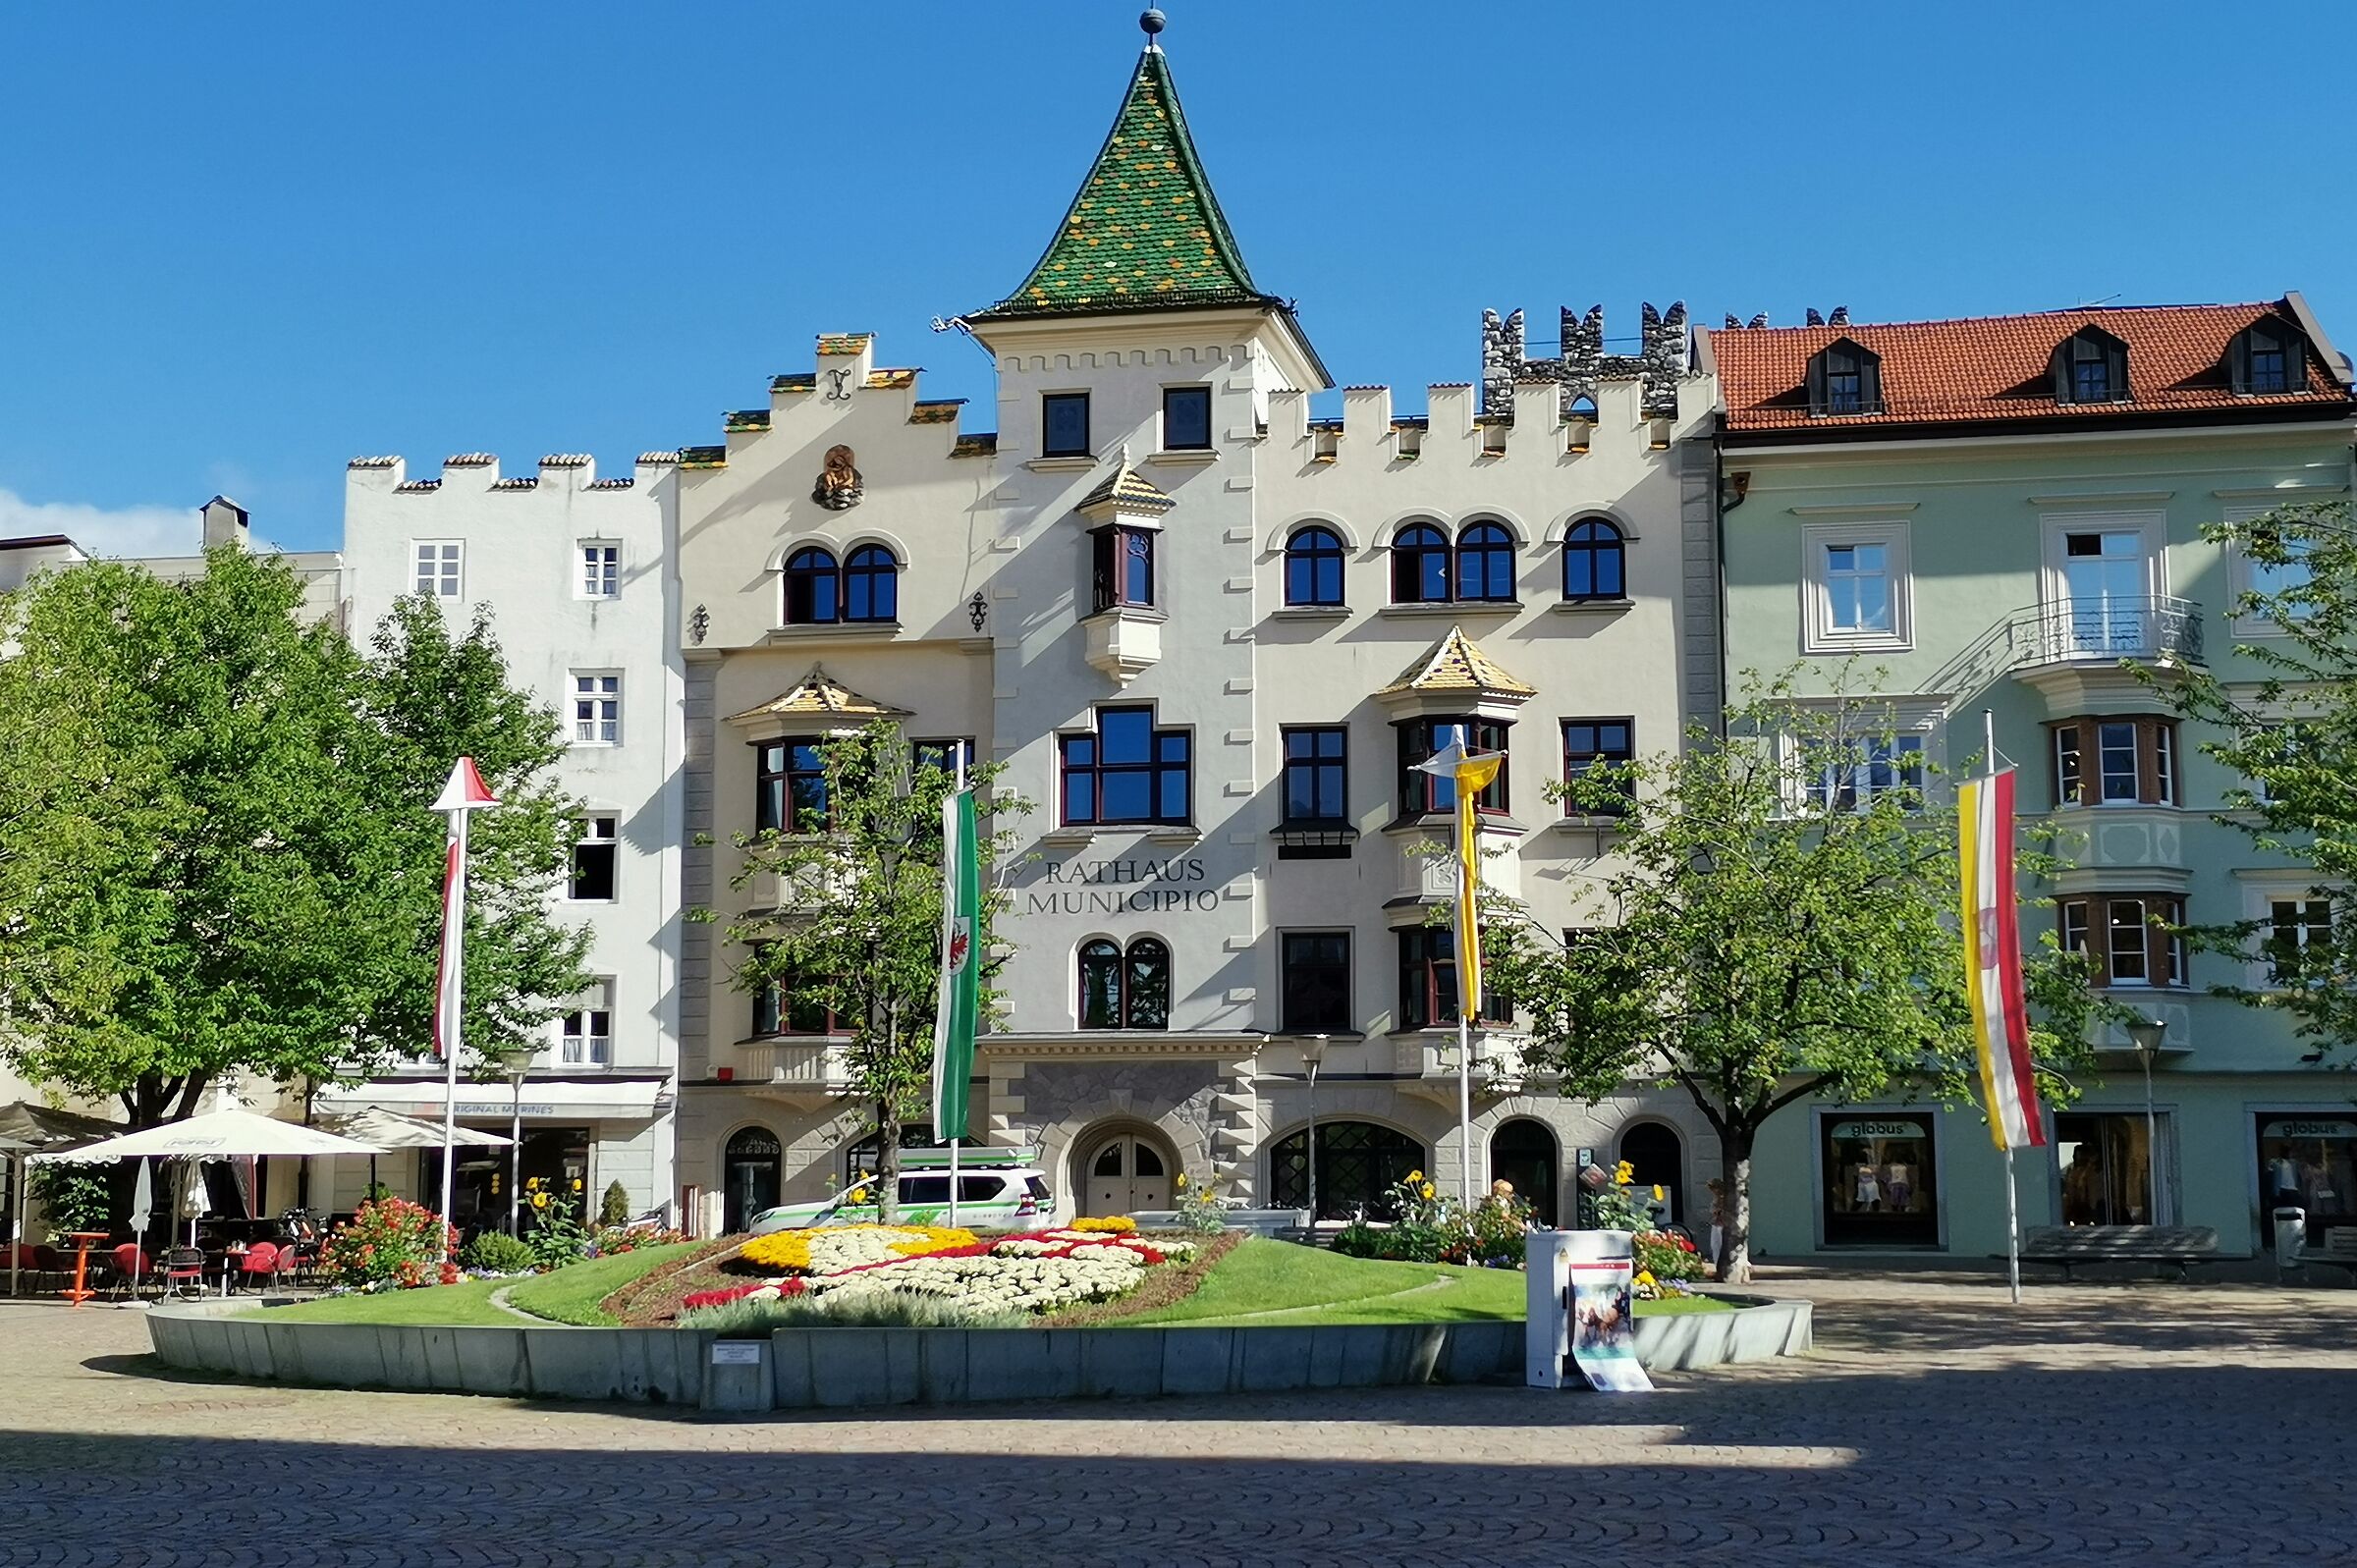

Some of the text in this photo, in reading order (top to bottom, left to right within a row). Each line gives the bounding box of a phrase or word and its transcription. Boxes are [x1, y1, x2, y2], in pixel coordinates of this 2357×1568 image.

[1045, 858, 1205, 884] RATHAUS
[1027, 889, 1220, 915] MUNICIPIO
[444, 1105, 499, 1114] RIGINAL
[1851, 1121, 1903, 1137] globus
[2282, 1121, 2339, 1137] globus
